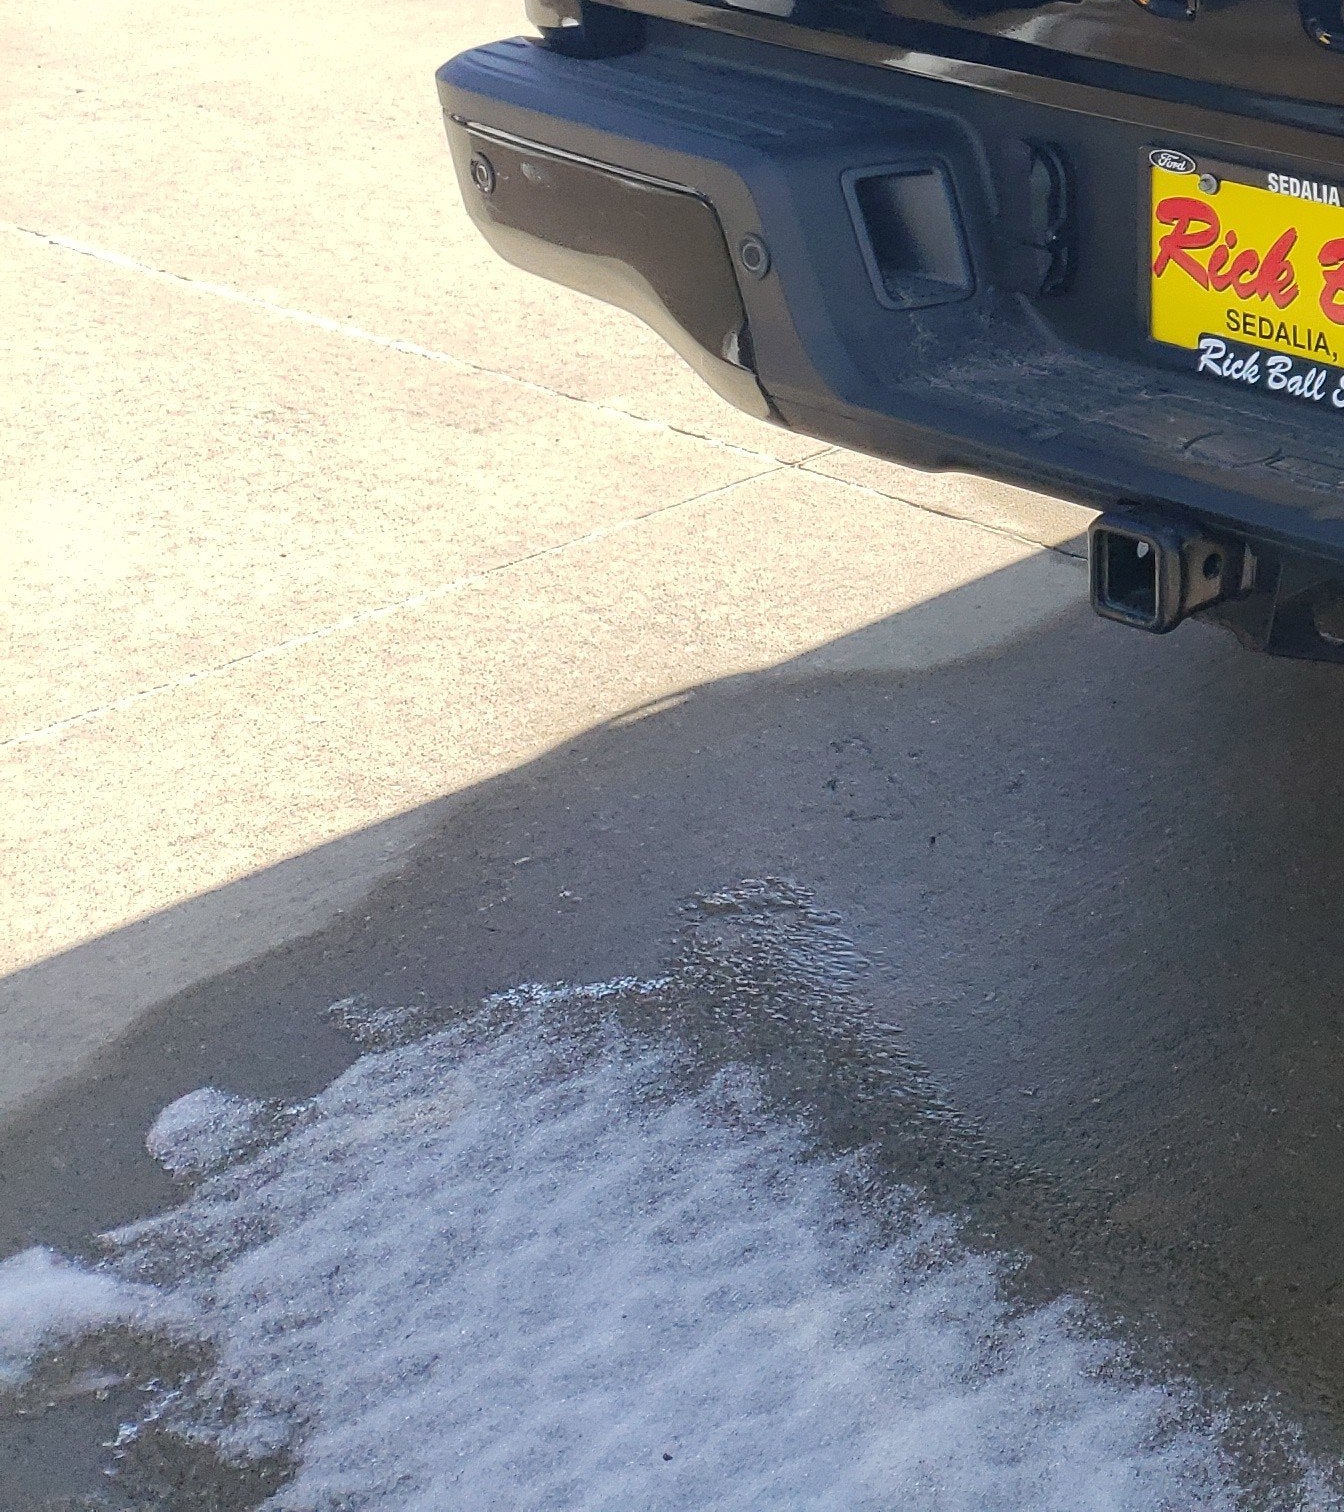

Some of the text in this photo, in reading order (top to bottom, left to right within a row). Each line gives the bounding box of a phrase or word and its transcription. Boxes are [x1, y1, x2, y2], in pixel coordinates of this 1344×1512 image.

[1158, 151, 1187, 172] Ford
[1268, 173, 1342, 206] SEDALIA
[1153, 196, 1299, 309] Rick
[1226, 309, 1339, 362] SEDALIA,
[1198, 339, 1260, 384] Rick
[1267, 355, 1326, 402] Ball
